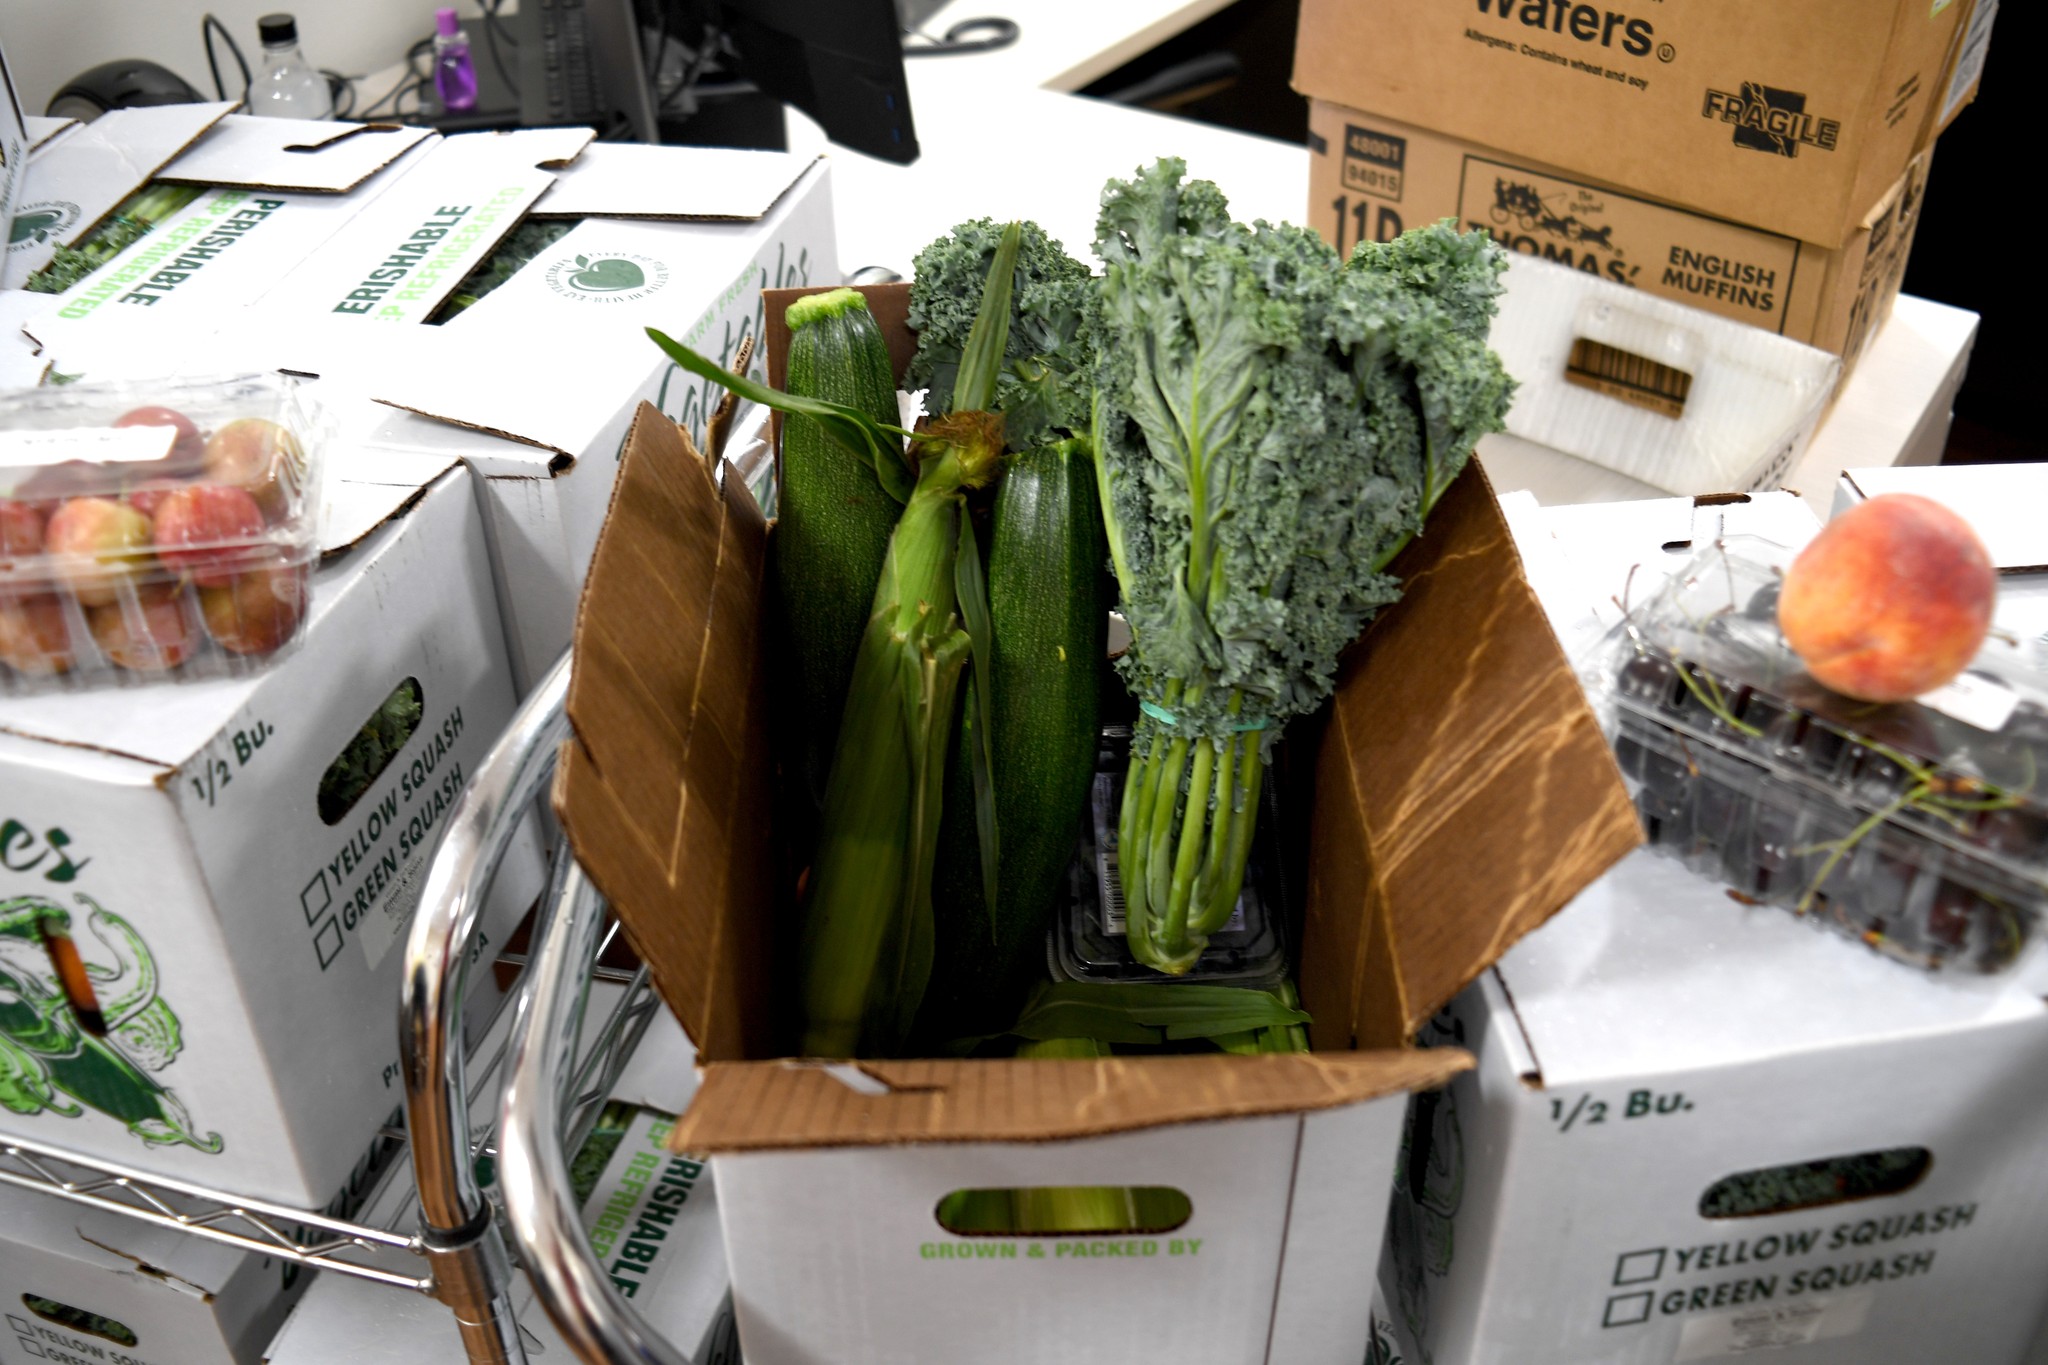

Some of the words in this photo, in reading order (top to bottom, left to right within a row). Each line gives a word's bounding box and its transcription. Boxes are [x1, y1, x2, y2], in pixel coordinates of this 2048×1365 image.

[1520, 44, 1568, 67] Contains
[1570, 59, 1602, 78] wheat
[1604, 68, 1626, 83] and
[1628, 75, 1650, 91] soy
[1702, 88, 1841, 151] FRAGILE
[1350, 134, 1400, 162] 48001
[1348, 164, 1398, 192] 94015
[57, 216, 213, 319] REFRIGERATED
[117, 199, 287, 307] PERISHABLE
[1669, 245, 1776, 290] ENGLISH
[1662, 267, 1774, 312] MUFFINS
[683, 309, 715, 348] ARM
[191, 759, 232, 808] 1/2
[232, 720, 274, 767] Bu.
[328, 788, 398, 886] YELLOW
[400, 706, 464, 802] SQUASH
[342, 848, 398, 931] GREEN
[399, 762, 464, 858] SQUASH
[1551, 1091, 1609, 1134] 1/2
[1624, 1088, 1694, 1119] Bu.
[920, 1242, 1017, 1260] GROWN
[1027, 1242, 1046, 1258] &
[1055, 1240, 1158, 1259] PACKED
[1168, 1238, 1203, 1257] BY
[1674, 1228, 1822, 1274] YELLOW
[1827, 1202, 1979, 1251] SQUASH
[1660, 1274, 1780, 1316] GREEN
[1786, 1249, 1936, 1295] SQUASH
[32, 1325, 105, 1360] YELLOW
